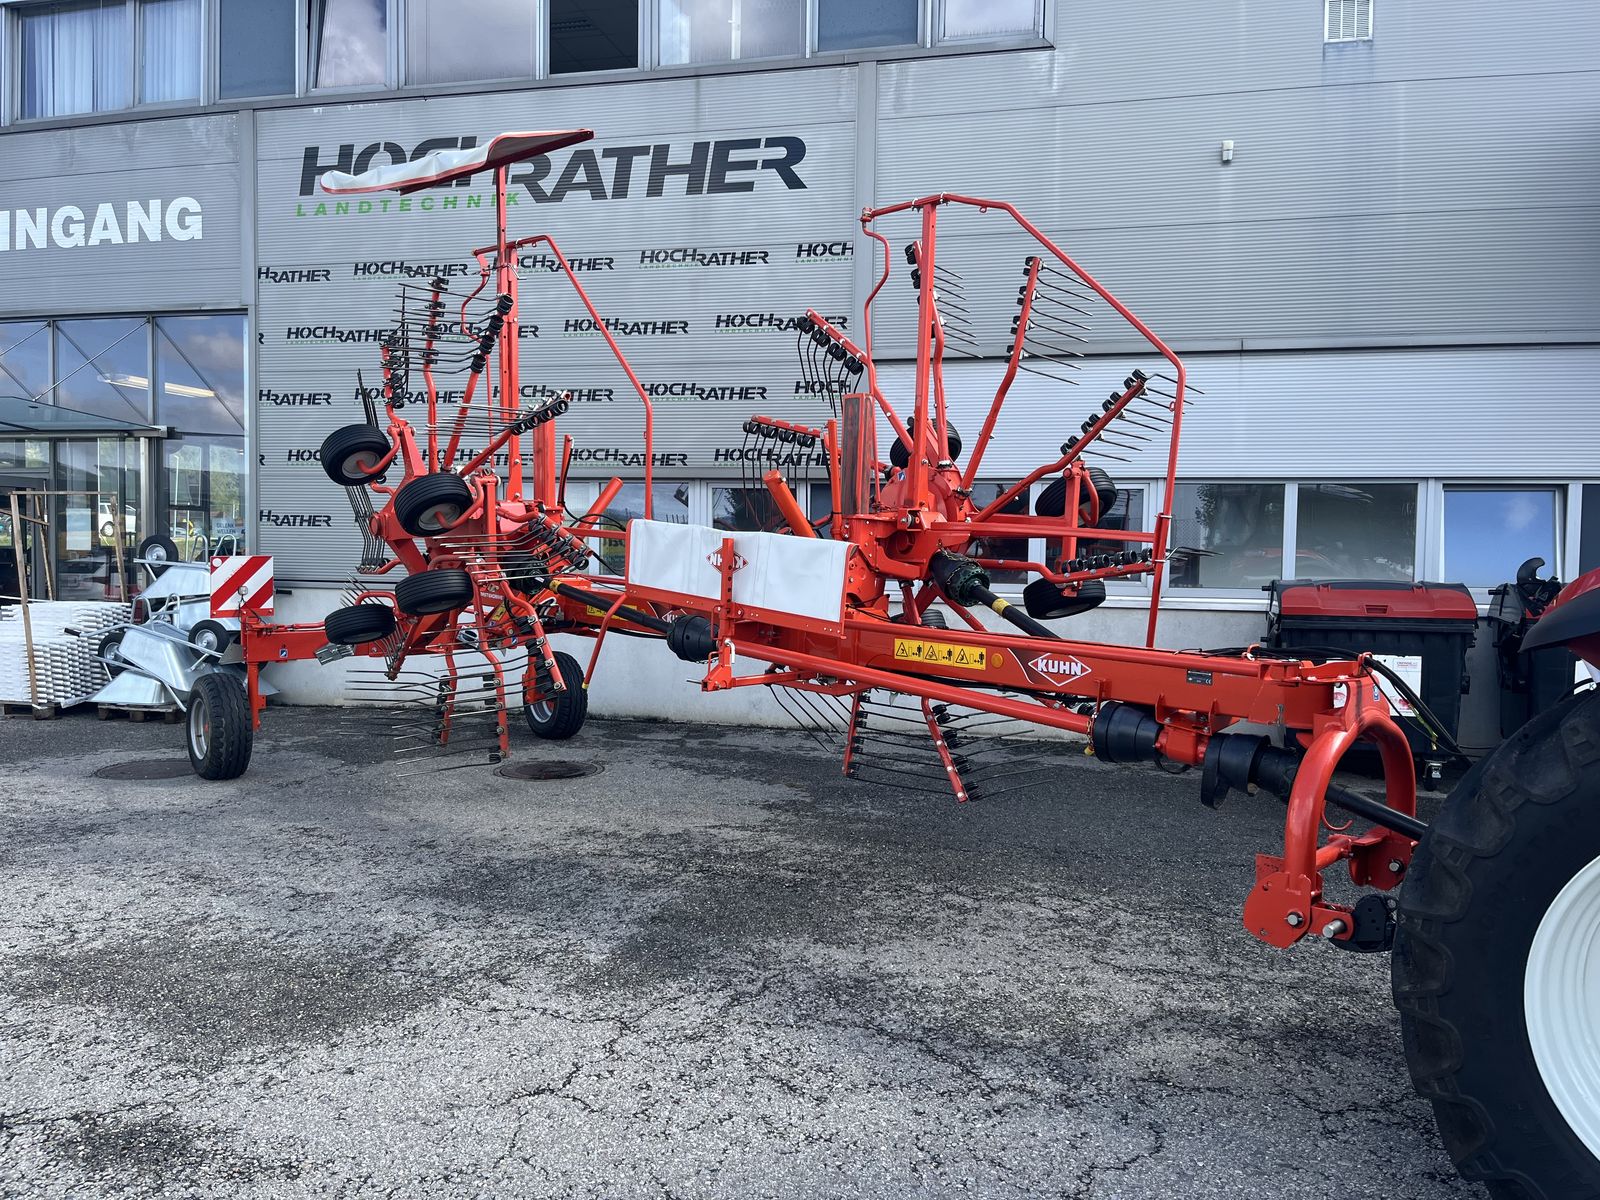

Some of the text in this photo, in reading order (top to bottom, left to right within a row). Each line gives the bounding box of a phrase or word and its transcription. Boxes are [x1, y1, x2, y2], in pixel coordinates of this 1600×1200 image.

[296, 192, 521, 217] LANDTECHNIK
[0, 196, 203, 250] INGANG
[639, 248, 769, 267] HOCHRATHER
[797, 242, 853, 258] HOCH
[353, 260, 468, 279] HOCHRATHER
[492, 254, 614, 273] CHRATHER
[563, 317, 688, 336] HOCHRATHER
[715, 313, 848, 332] HOCHRAER
[258, 389, 332, 406] HRATHER
[640, 382, 767, 401] HOCHRATHER
[714, 447, 842, 467] HOCHRATH
[259, 509, 332, 527] HRATHER
[1037, 657, 1083, 676] KUHN
